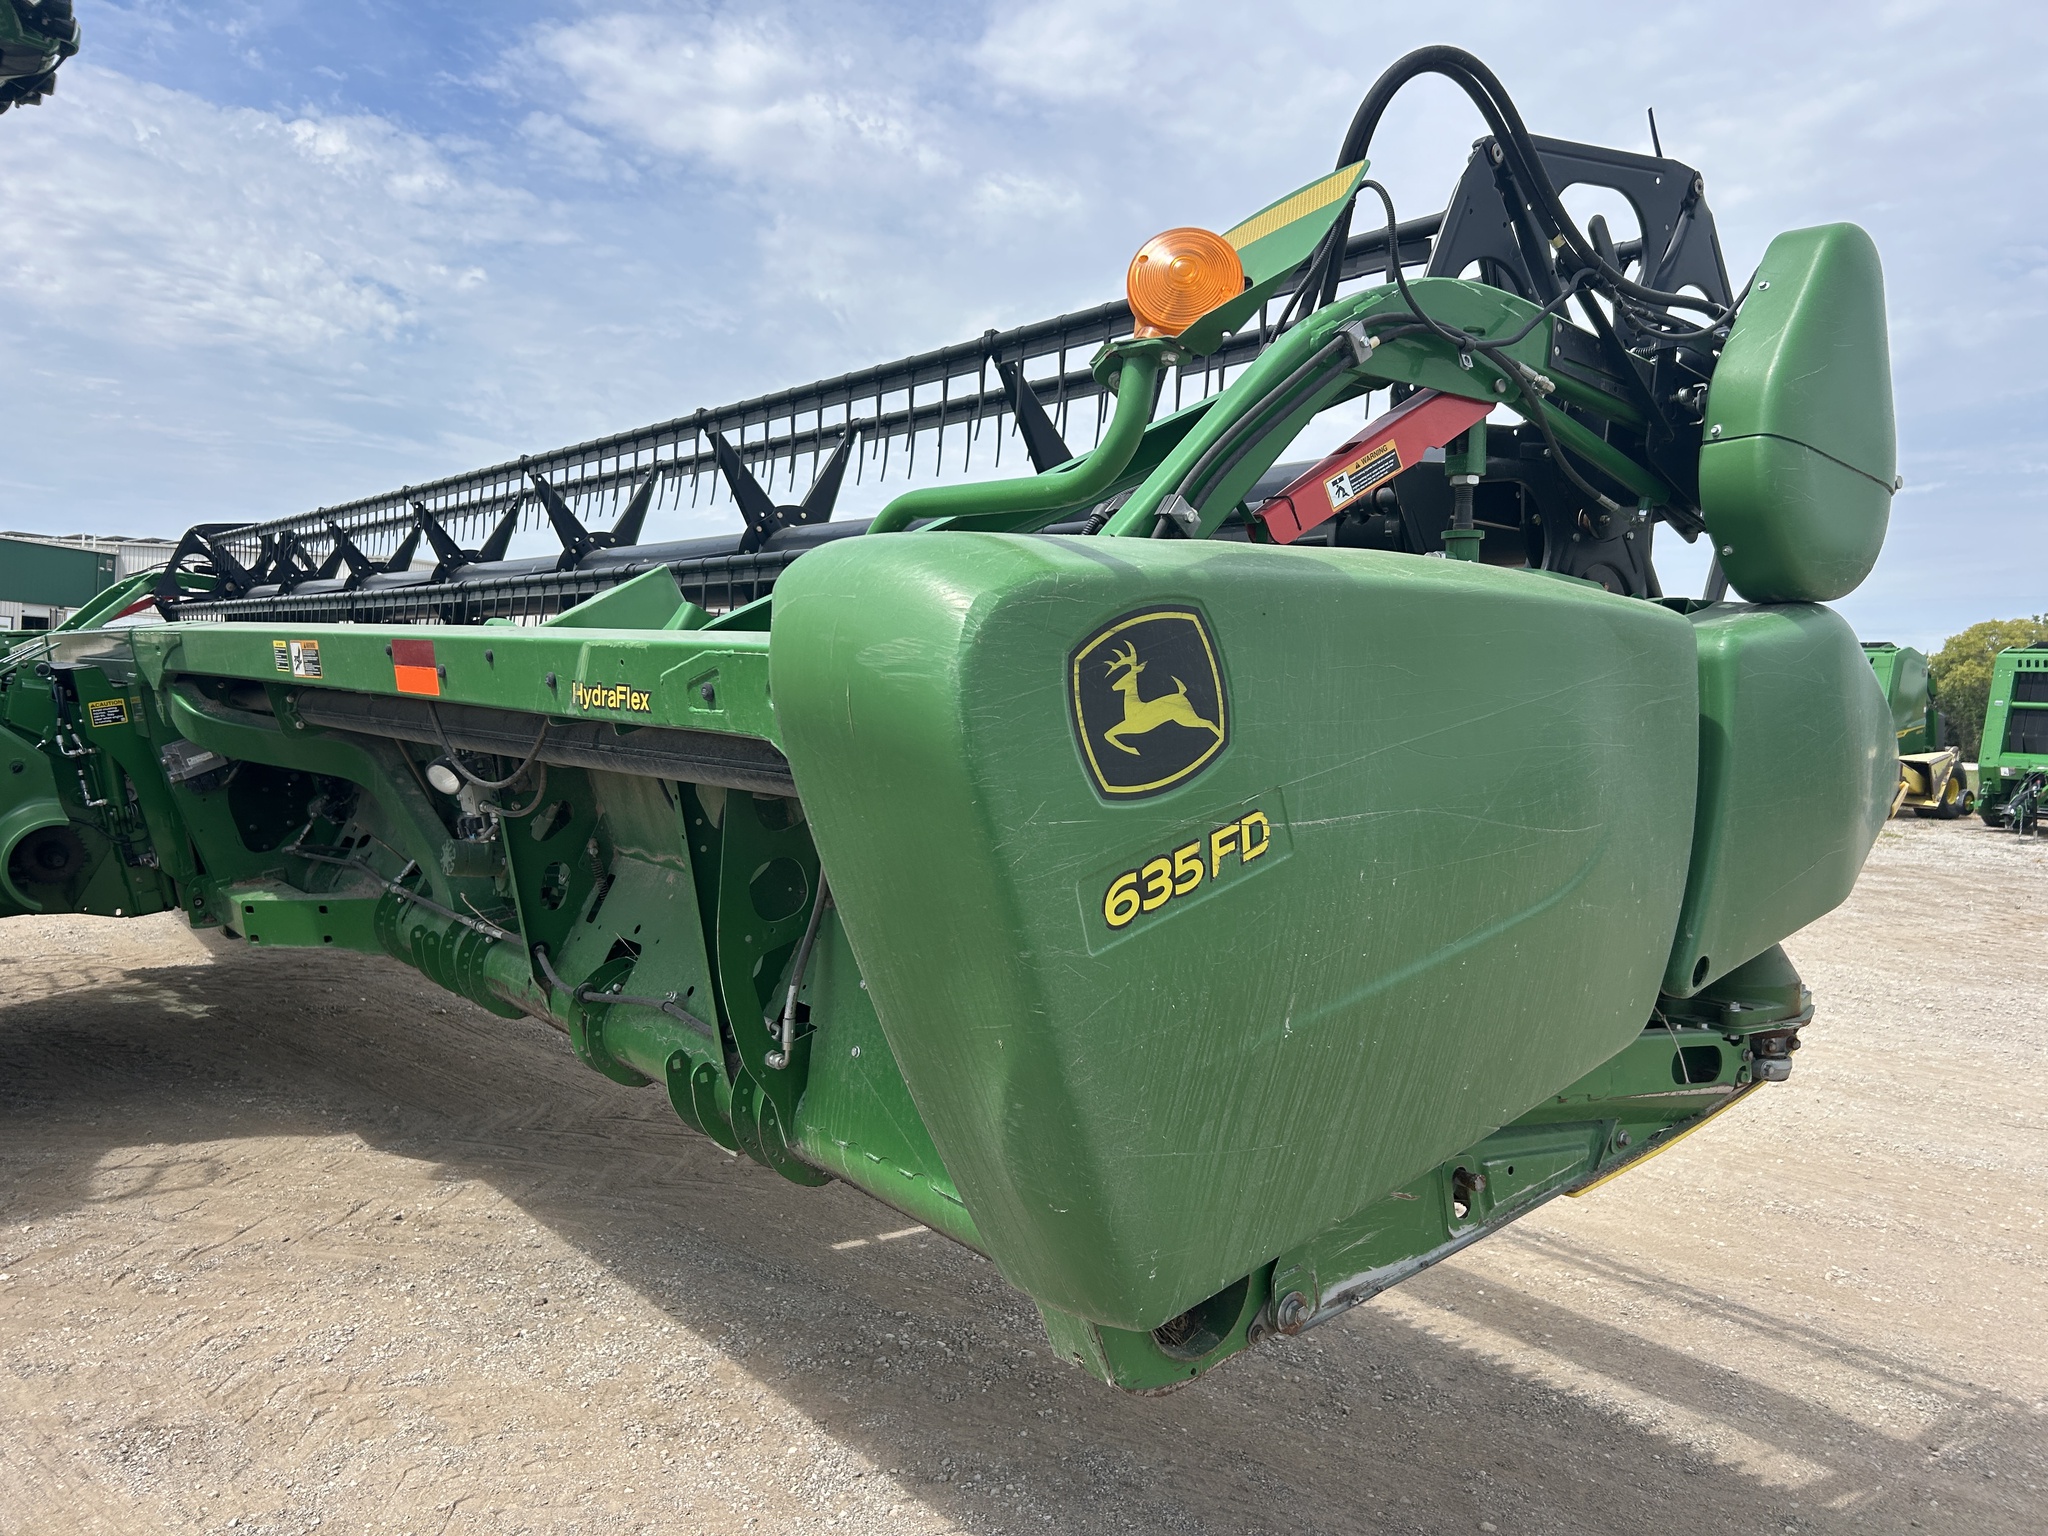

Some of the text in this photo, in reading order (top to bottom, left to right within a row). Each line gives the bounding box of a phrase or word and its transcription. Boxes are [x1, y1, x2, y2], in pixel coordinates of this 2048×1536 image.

[1361, 445, 1387, 464] WARNING
[95, 700, 122, 708] CAUTION
[572, 681, 651, 713] HydraFlex
